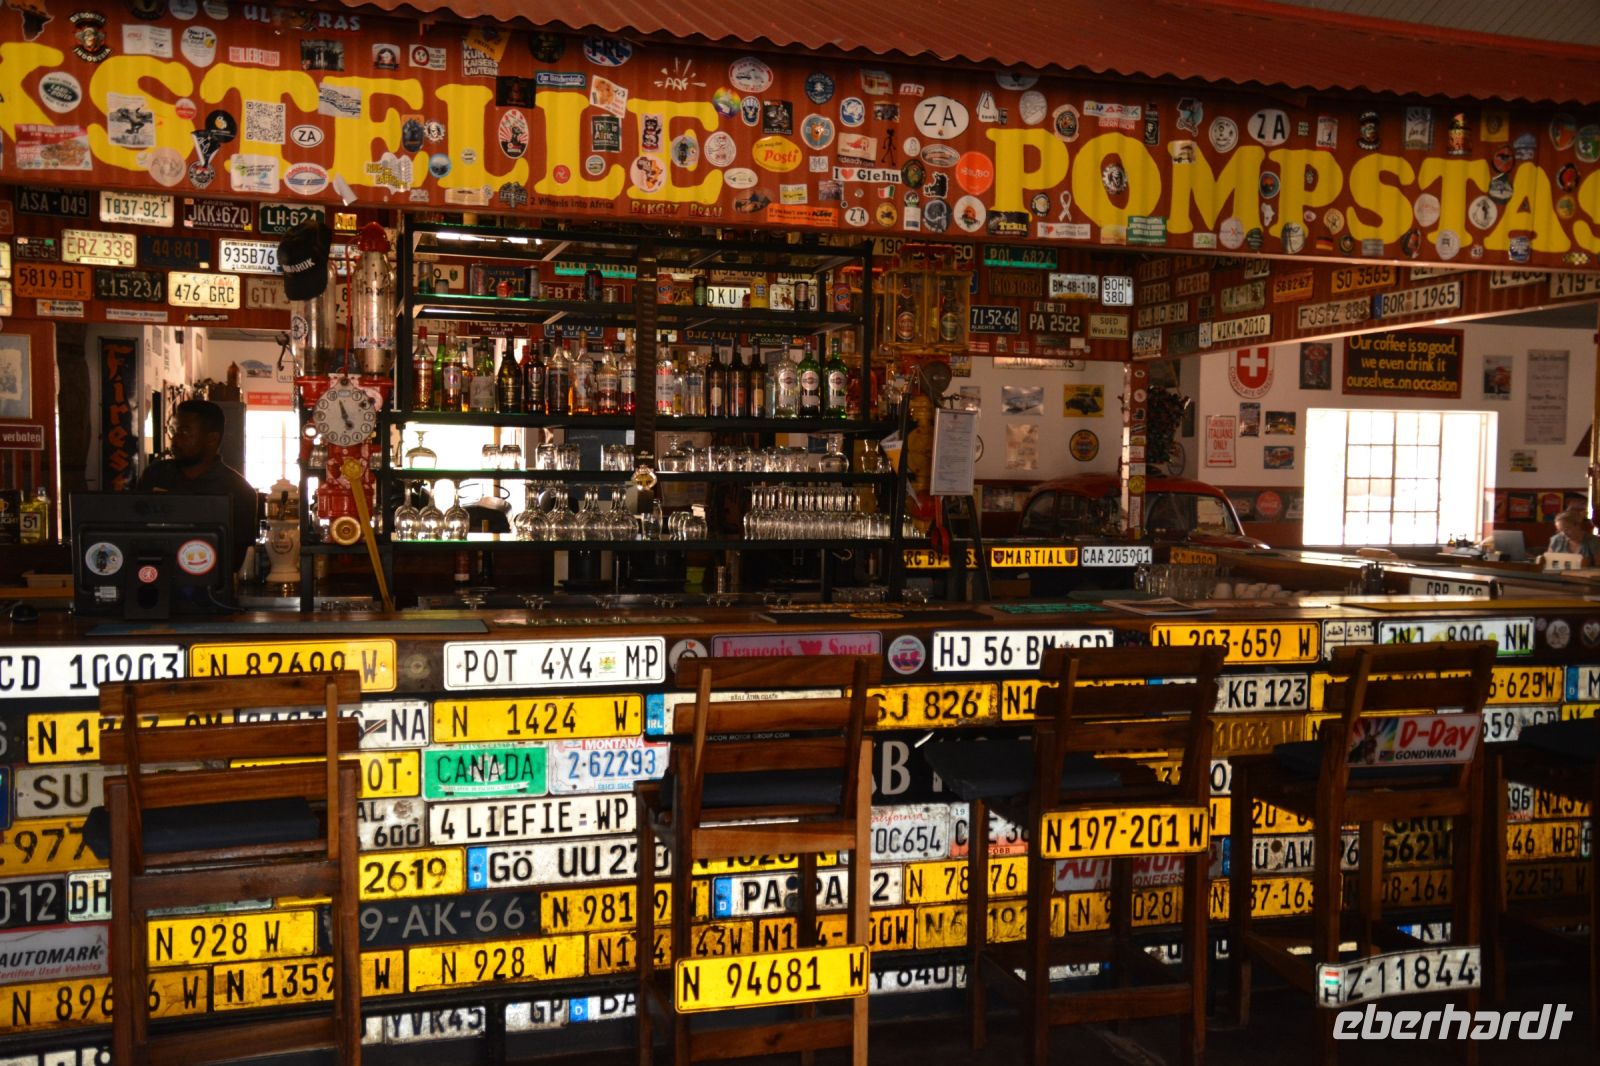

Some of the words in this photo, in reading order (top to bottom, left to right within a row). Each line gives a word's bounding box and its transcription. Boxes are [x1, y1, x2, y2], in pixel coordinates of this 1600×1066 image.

[299, 130, 317, 142] ZA
[857, 169, 900, 182] Glehn
[187, 203, 216, 222] JKK
[223, 205, 250, 225] 670
[66, 237, 97, 256] ERZ
[103, 239, 134, 259] 338
[1103, 278, 1125, 292] BOH
[1357, 266, 1391, 286] 3565
[174, 283, 201, 301] 476
[209, 285, 235, 304] GRC
[1103, 291, 1125, 304] 380
[1382, 294, 1405, 315] BOR
[1422, 287, 1456, 308] 1965
[1029, 313, 1047, 331] PA
[1049, 315, 1081, 333] 2522
[1099, 317, 1119, 326] SUED
[1243, 316, 1266, 336] 2010
[1349, 333, 1372, 351] Our
[1373, 334, 1407, 352] coffee
[1361, 356, 1377, 369] we
[1378, 357, 1405, 371] even
[1406, 355, 1435, 372] drink
[1437, 357, 1446, 371] it
[1413, 377, 1458, 392] occasion
[3, 432, 42, 444] verboten
[1208, 428, 1233, 439] ITALIANS
[1213, 439, 1228, 450] ONLY
[23, 516, 39, 529] 51
[1005, 548, 1062, 566] MARTIAL
[1081, 548, 1105, 564] CAA
[1107, 547, 1151, 565] 205901
[1298, 628, 1310, 657] W
[1505, 623, 1530, 649] NW
[463, 648, 518, 683] POT
[541, 646, 593, 681] 4X4
[625, 644, 659, 678] MP
[938, 636, 969, 667] HJ
[984, 635, 1014, 667] 56
[360, 649, 378, 684] W
[924, 687, 979, 721] 826
[1227, 680, 1258, 709] KG
[1263, 678, 1306, 708] 123
[390, 707, 426, 742] NA
[452, 705, 468, 738] N
[506, 702, 576, 736] 1424
[614, 700, 628, 732] W
[37, 720, 57, 756] N
[585, 738, 645, 750] MONTANA
[1399, 718, 1477, 751] D-Day
[1394, 748, 1457, 761] GONDWANA
[436, 753, 535, 785] CANADA
[33, 772, 90, 810] SU
[440, 804, 456, 840] 4
[466, 801, 573, 839] LIEFIE
[596, 797, 629, 831] WP
[373, 824, 420, 847] 600
[557, 846, 600, 878] UU
[742, 880, 782, 911] PA
[909, 868, 924, 899] N
[552, 895, 569, 928] N
[1077, 897, 1090, 927] N
[155, 927, 174, 961] N
[190, 922, 249, 958] 928
[264, 920, 281, 954] W
[0, 944, 101, 970] AUTOMARK
[441, 951, 457, 985] N
[474, 946, 526, 980] 928
[543, 943, 558, 975] W
[40, 965, 62, 978] Used
[226, 969, 245, 1004] N
[374, 957, 391, 990] W
[682, 965, 700, 1003] N
[726, 955, 822, 999] 94681
[849, 945, 865, 988] W
[1347, 952, 1477, 1002] Z-11844
[12, 989, 32, 1027] N
[182, 976, 199, 1010] W
